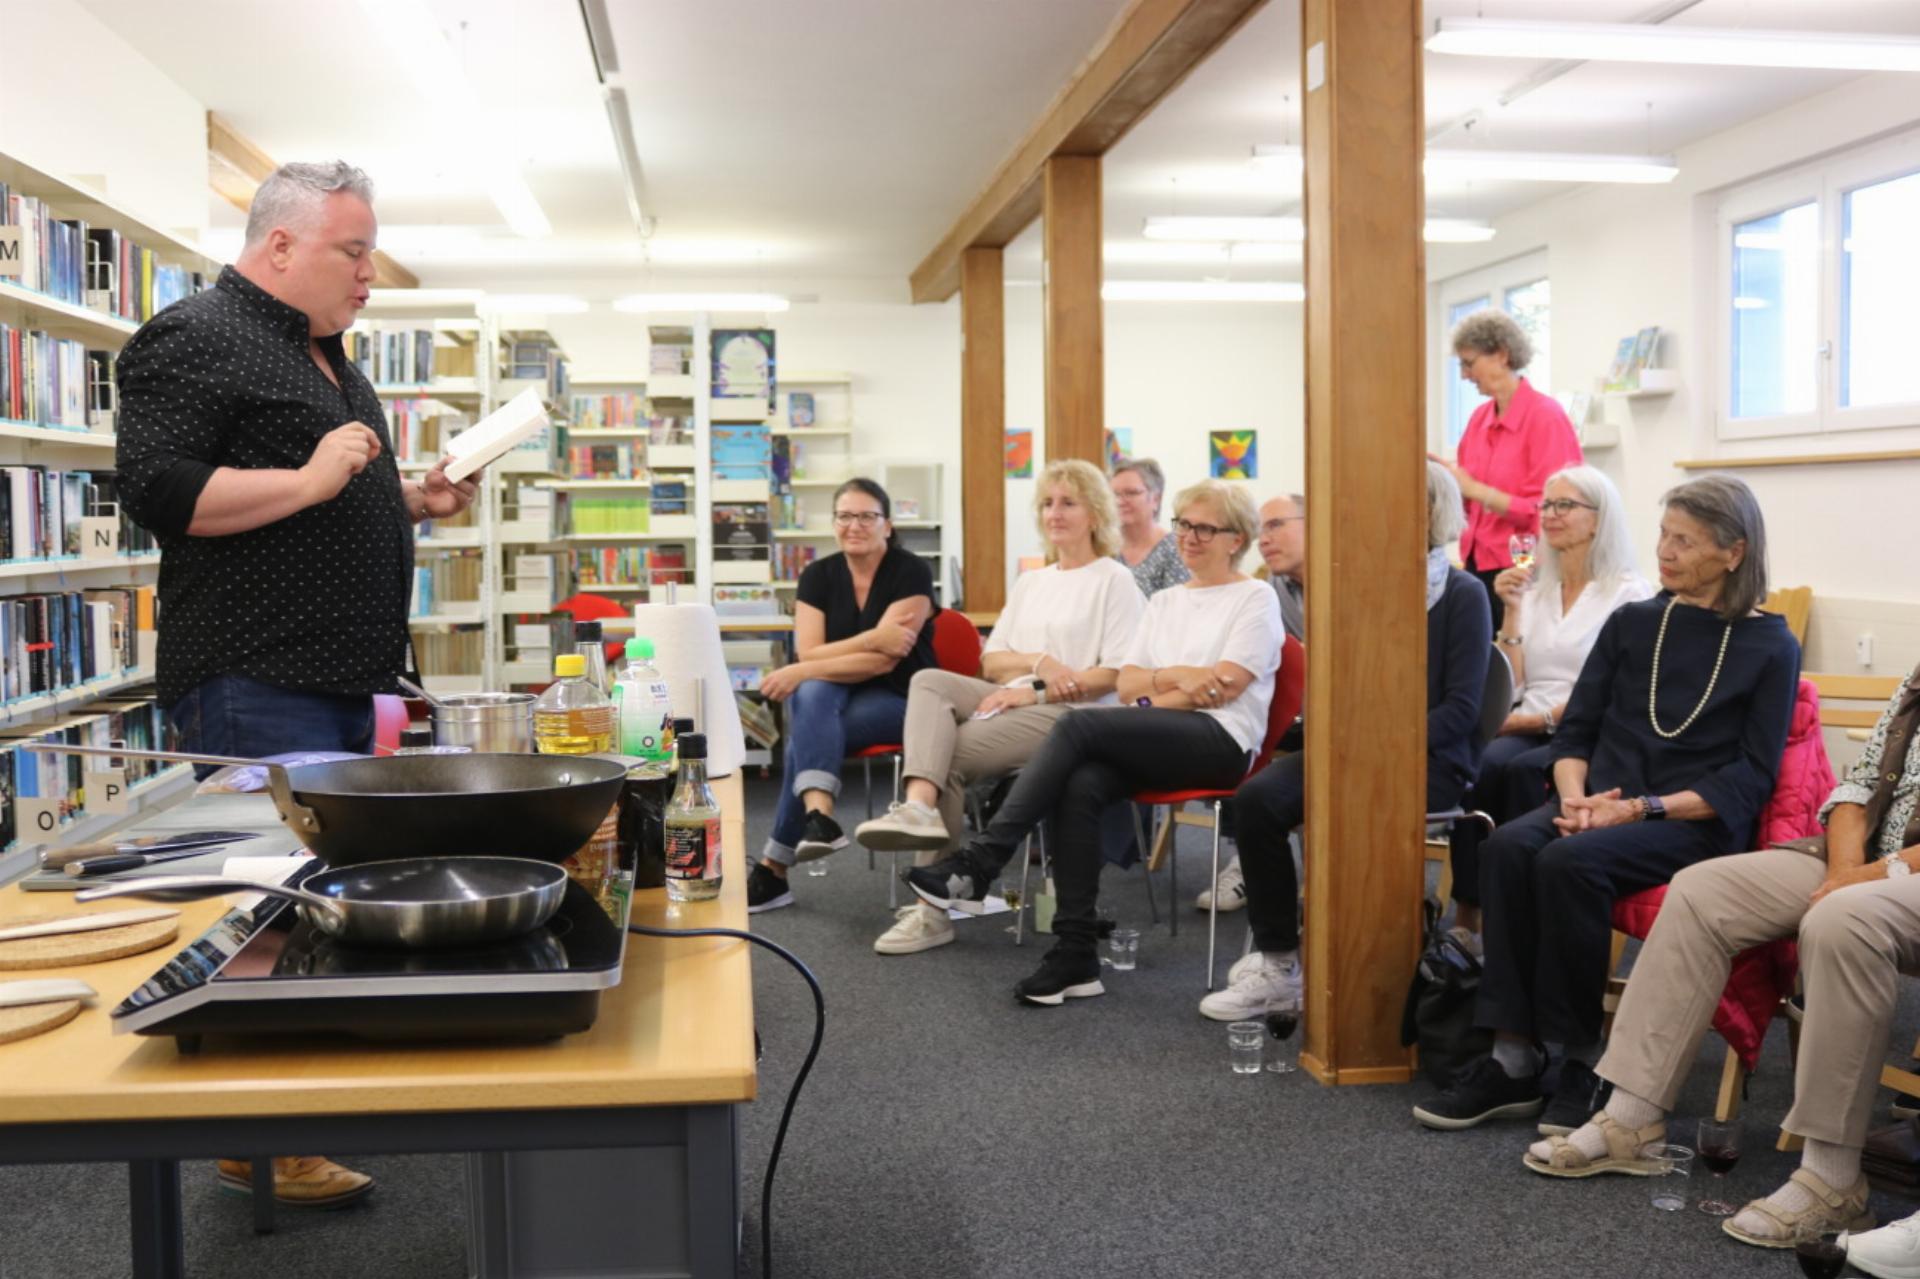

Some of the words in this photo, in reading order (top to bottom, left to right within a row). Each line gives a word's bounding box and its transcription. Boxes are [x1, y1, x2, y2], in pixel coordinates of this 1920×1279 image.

[0, 241, 21, 260] M
[95, 529, 110, 547] N
[106, 783, 119, 801] P
[37, 811, 54, 831] O
